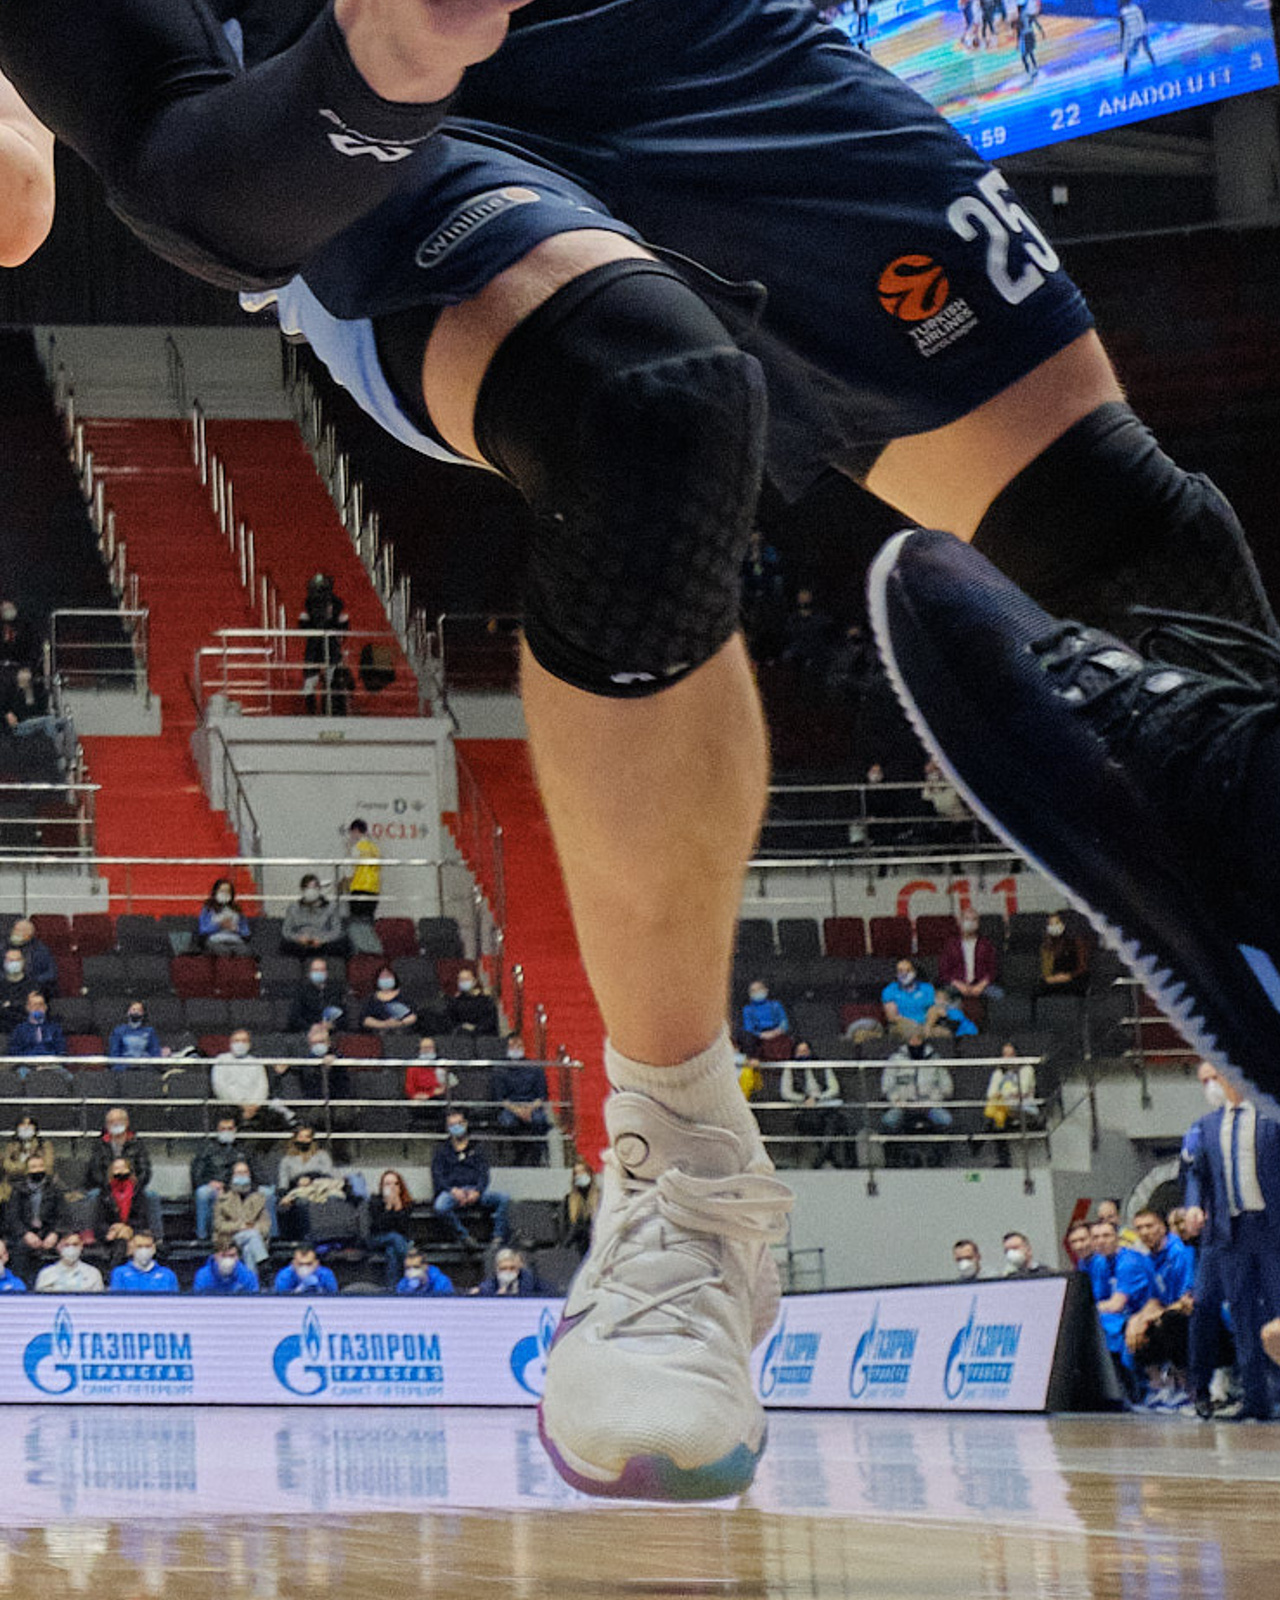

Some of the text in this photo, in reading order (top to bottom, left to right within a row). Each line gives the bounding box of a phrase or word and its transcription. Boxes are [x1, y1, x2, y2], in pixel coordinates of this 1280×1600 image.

[1050, 103, 1081, 131] 22
[948, 171, 1061, 306] 25
[79, 1332, 193, 1360] ГАЗПРОМ
[328, 1334, 441, 1361] ГАЗПРОМ
[83, 1365, 193, 1380] ТРАНСГАЗ
